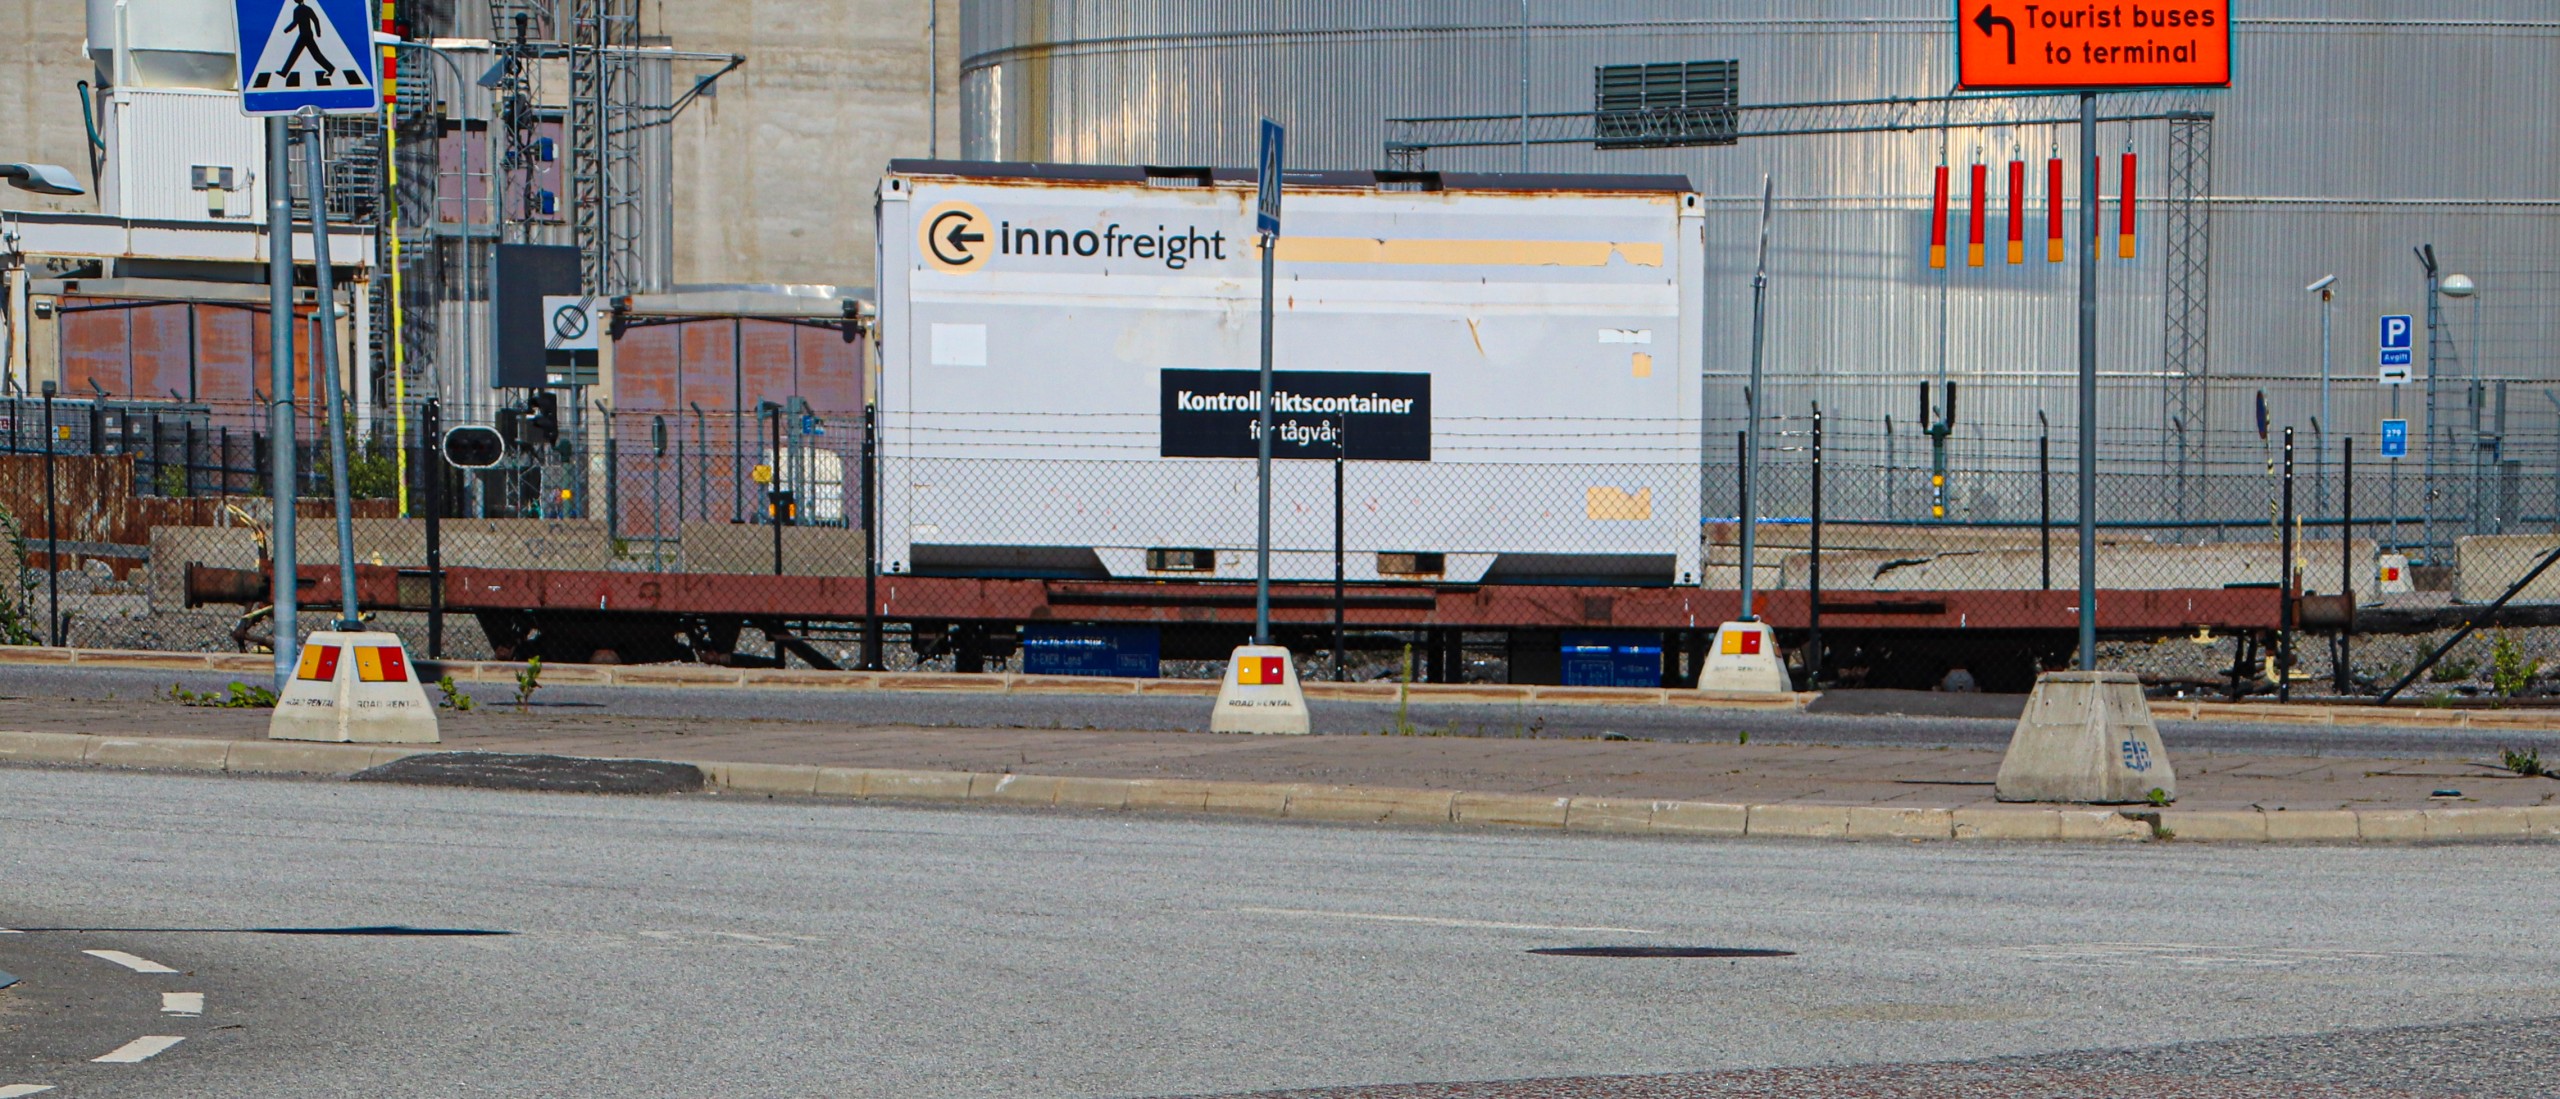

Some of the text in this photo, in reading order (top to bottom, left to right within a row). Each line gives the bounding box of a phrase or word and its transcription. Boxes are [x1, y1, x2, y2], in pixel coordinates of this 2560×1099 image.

[2025, 4, 2215, 29] Tourist buses
[2045, 40, 2196, 64] to terminal
[1001, 221, 1226, 269] innofreight
[2388, 319, 2406, 345] P
[2384, 353, 2408, 363] Avgift
[1177, 390, 1414, 414] Kontrolliktscontainer
